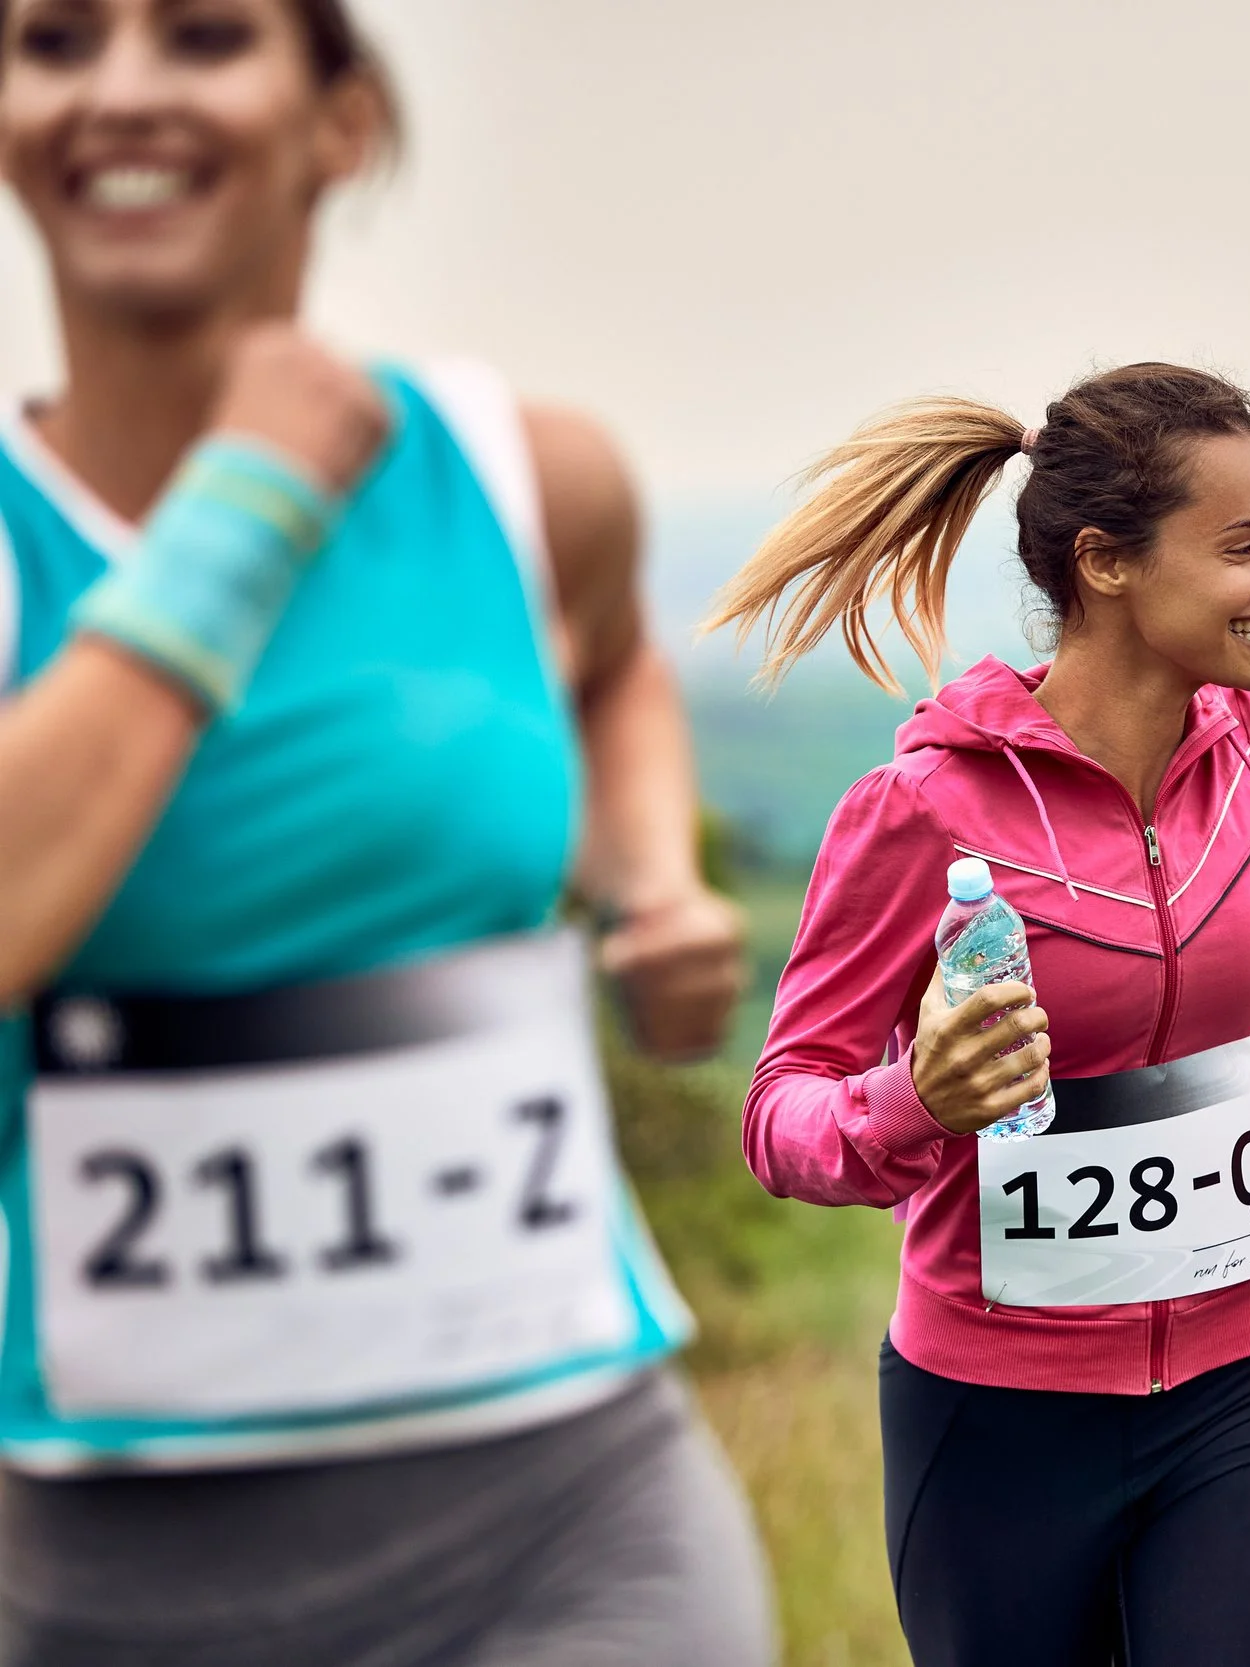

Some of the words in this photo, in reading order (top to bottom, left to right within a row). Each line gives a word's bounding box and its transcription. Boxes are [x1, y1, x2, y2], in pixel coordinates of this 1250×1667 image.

[76, 1094, 577, 1294] 211-Z
[1193, 1264, 1218, 1278] run
[1222, 1249, 1246, 1279] for
